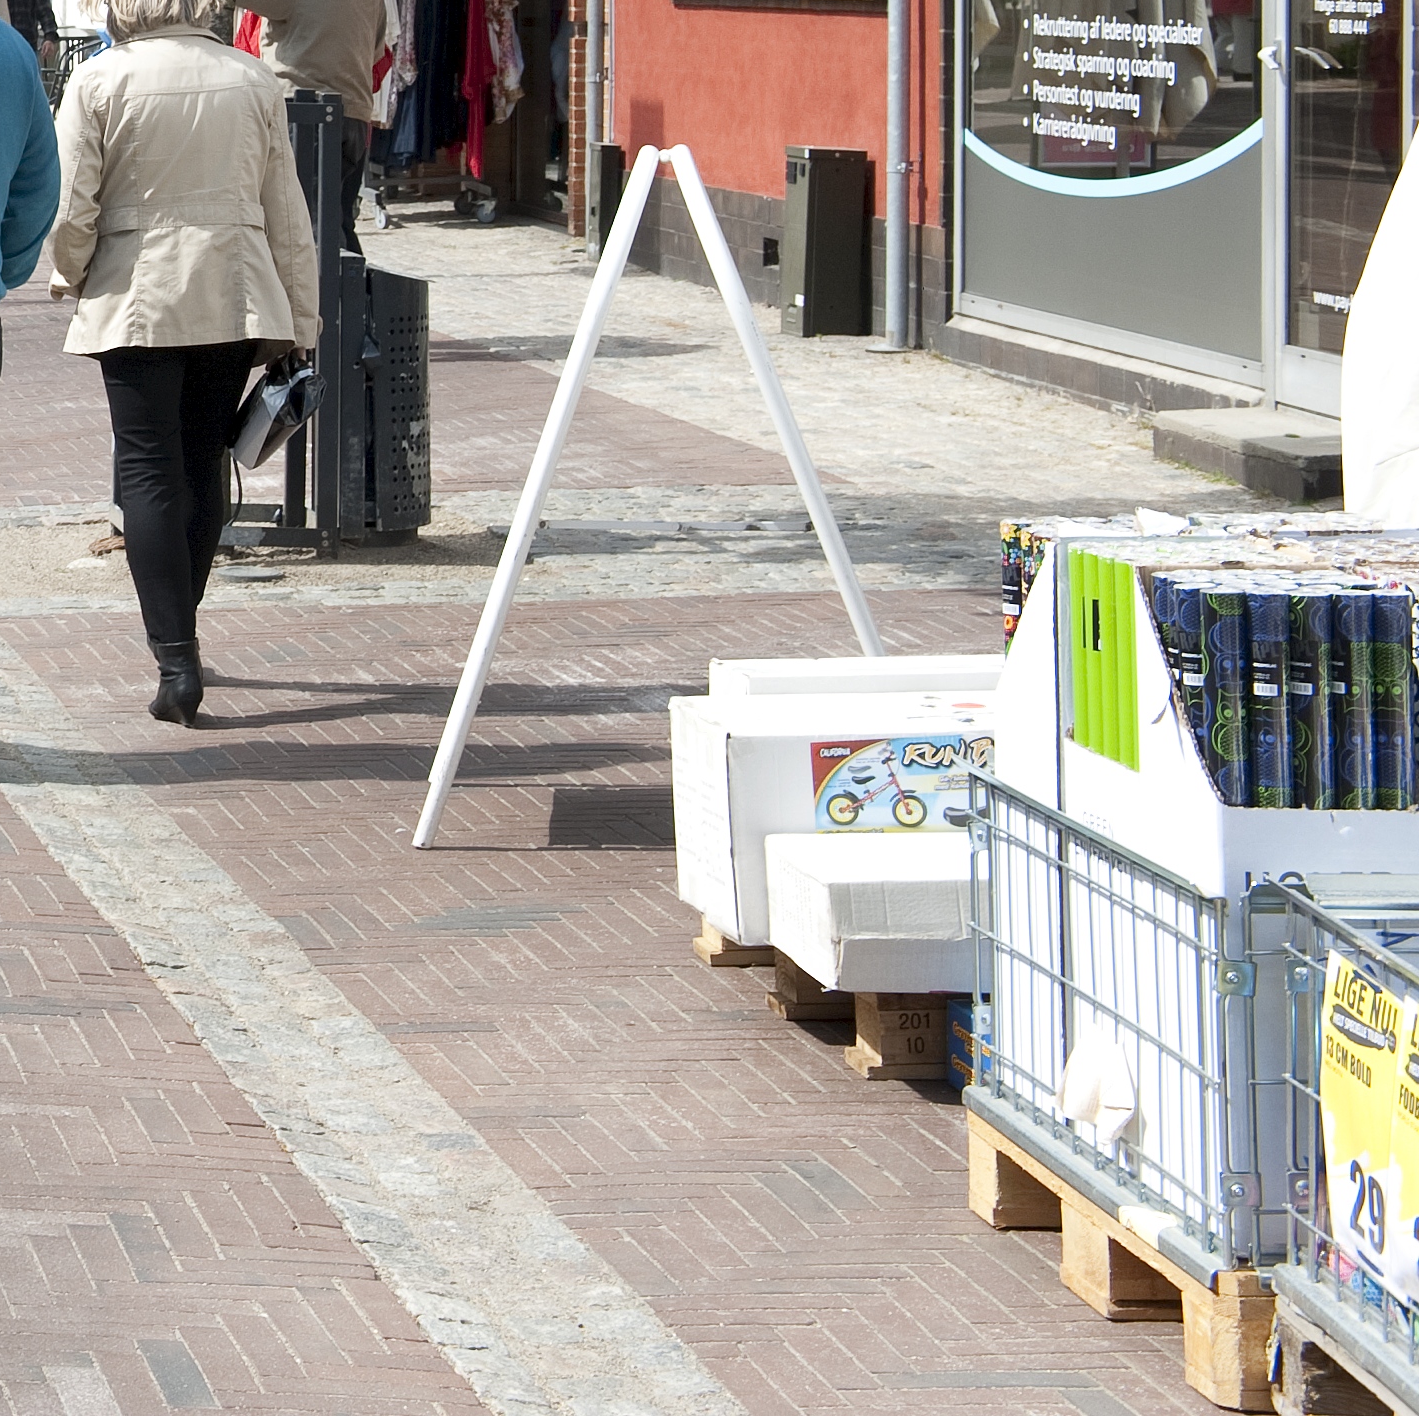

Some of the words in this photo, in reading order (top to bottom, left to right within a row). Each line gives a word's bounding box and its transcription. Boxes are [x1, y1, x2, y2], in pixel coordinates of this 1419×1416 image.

[1033, 13, 1089, 45] Rekruttering
[1090, 15, 1101, 39] af
[1101, 16, 1132, 42] ledere
[1133, 23, 1147, 48] og
[1148, 19, 1203, 48] specialister
[1033, 46, 1076, 76] Strategisk
[1077, 50, 1115, 81] sparring
[1116, 57, 1130, 82] og
[1131, 53, 1176, 86] coaching
[1033, 79, 1079, 106] Persontest
[1080, 88, 1094, 113] og
[1094, 85, 1141, 118] vurdering
[1033, 112, 1117, 149] Karriererådgivning
[901, 737, 968, 769] RUN
[1334, 965, 1367, 1016] LIGE
[899, 1012, 931, 1030] 201
[906, 1036, 925, 1054] 10
[1326, 1034, 1335, 1059] 13
[1335, 1042, 1348, 1071] CM
[1350, 1053, 1372, 1088] BOLD
[1349, 1159, 1385, 1255] 29
